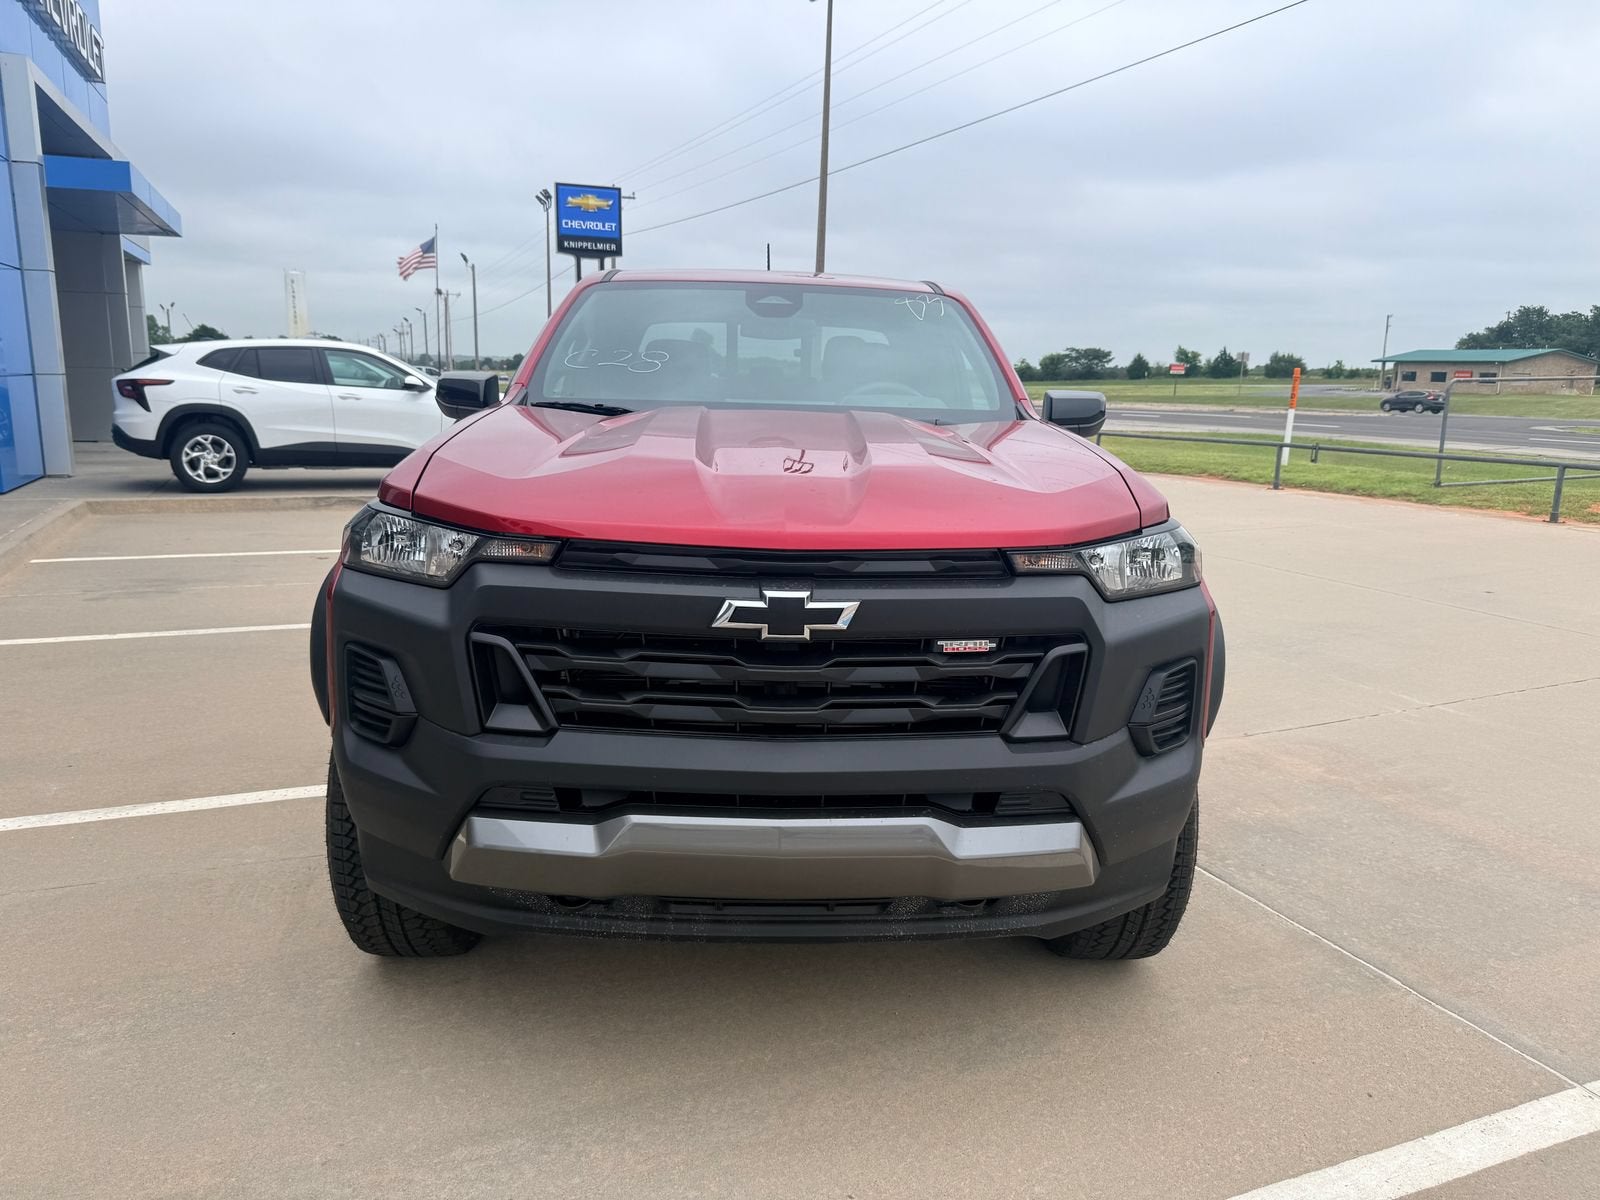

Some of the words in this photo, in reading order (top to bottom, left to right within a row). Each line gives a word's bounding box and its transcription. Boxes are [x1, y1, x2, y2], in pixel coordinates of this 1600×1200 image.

[562, 219, 617, 232] CHEVROLET
[564, 241, 617, 251] KNIPPELMIER
[937, 640, 996, 648] TRAIL
